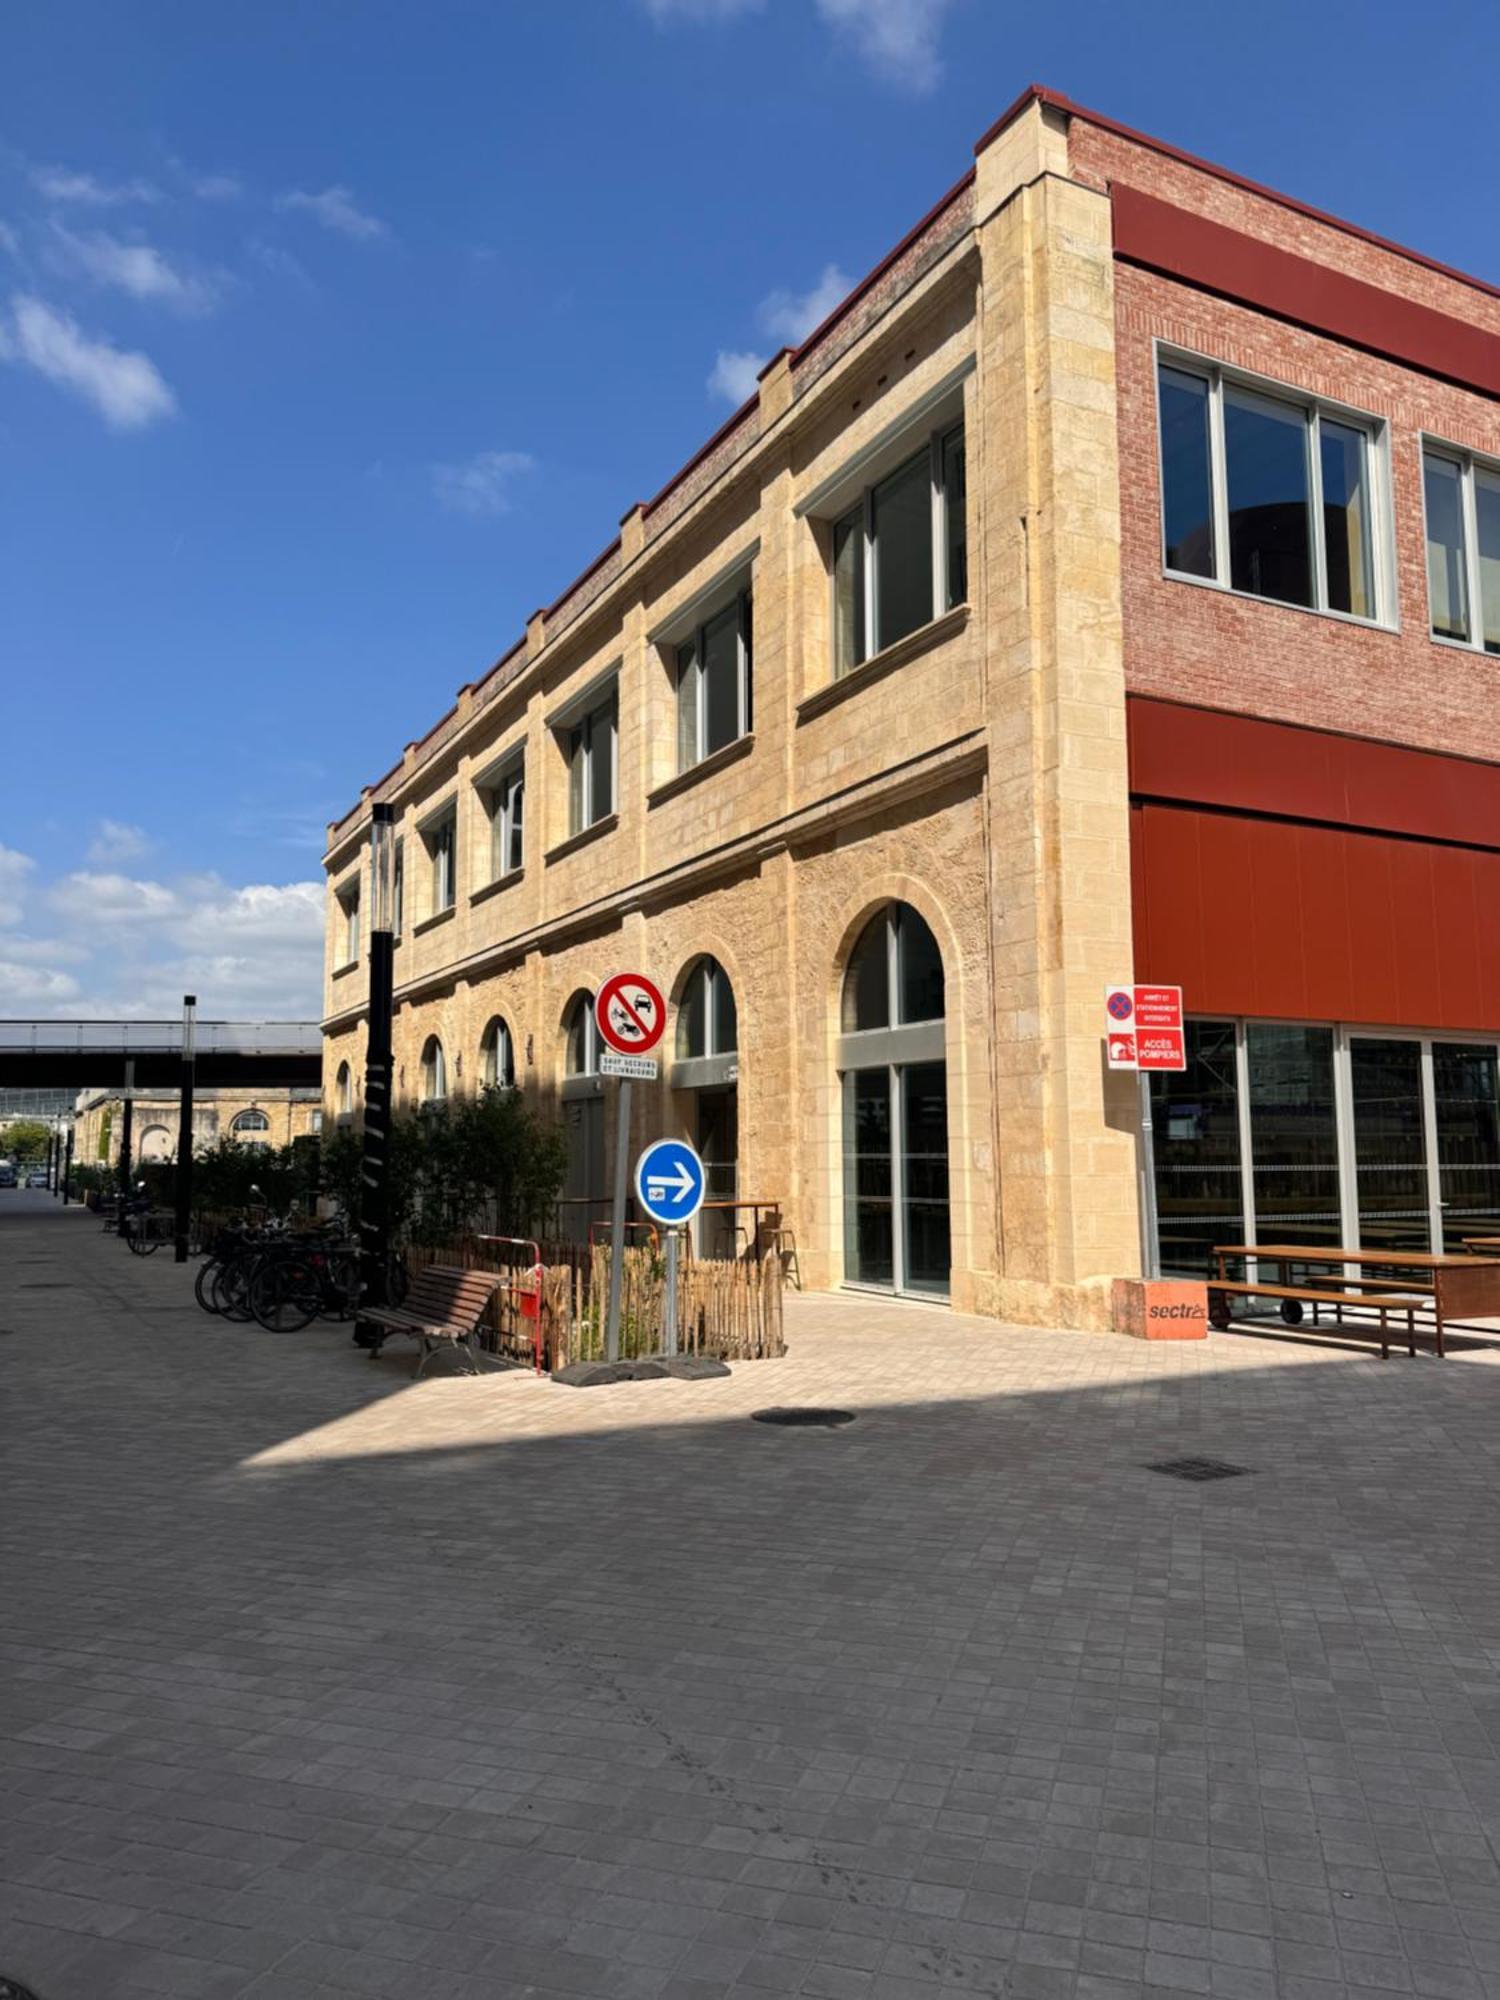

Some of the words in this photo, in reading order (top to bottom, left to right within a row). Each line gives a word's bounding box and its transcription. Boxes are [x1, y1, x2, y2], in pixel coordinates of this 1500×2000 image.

[1144, 1039, 1173, 1049] ACCÈS
[1139, 1049, 1181, 1060] POMPIERS
[604, 1057, 621, 1065] SAUF
[624, 1059, 656, 1069] SECOURS
[613, 1066, 655, 1077] LIVRAISONS
